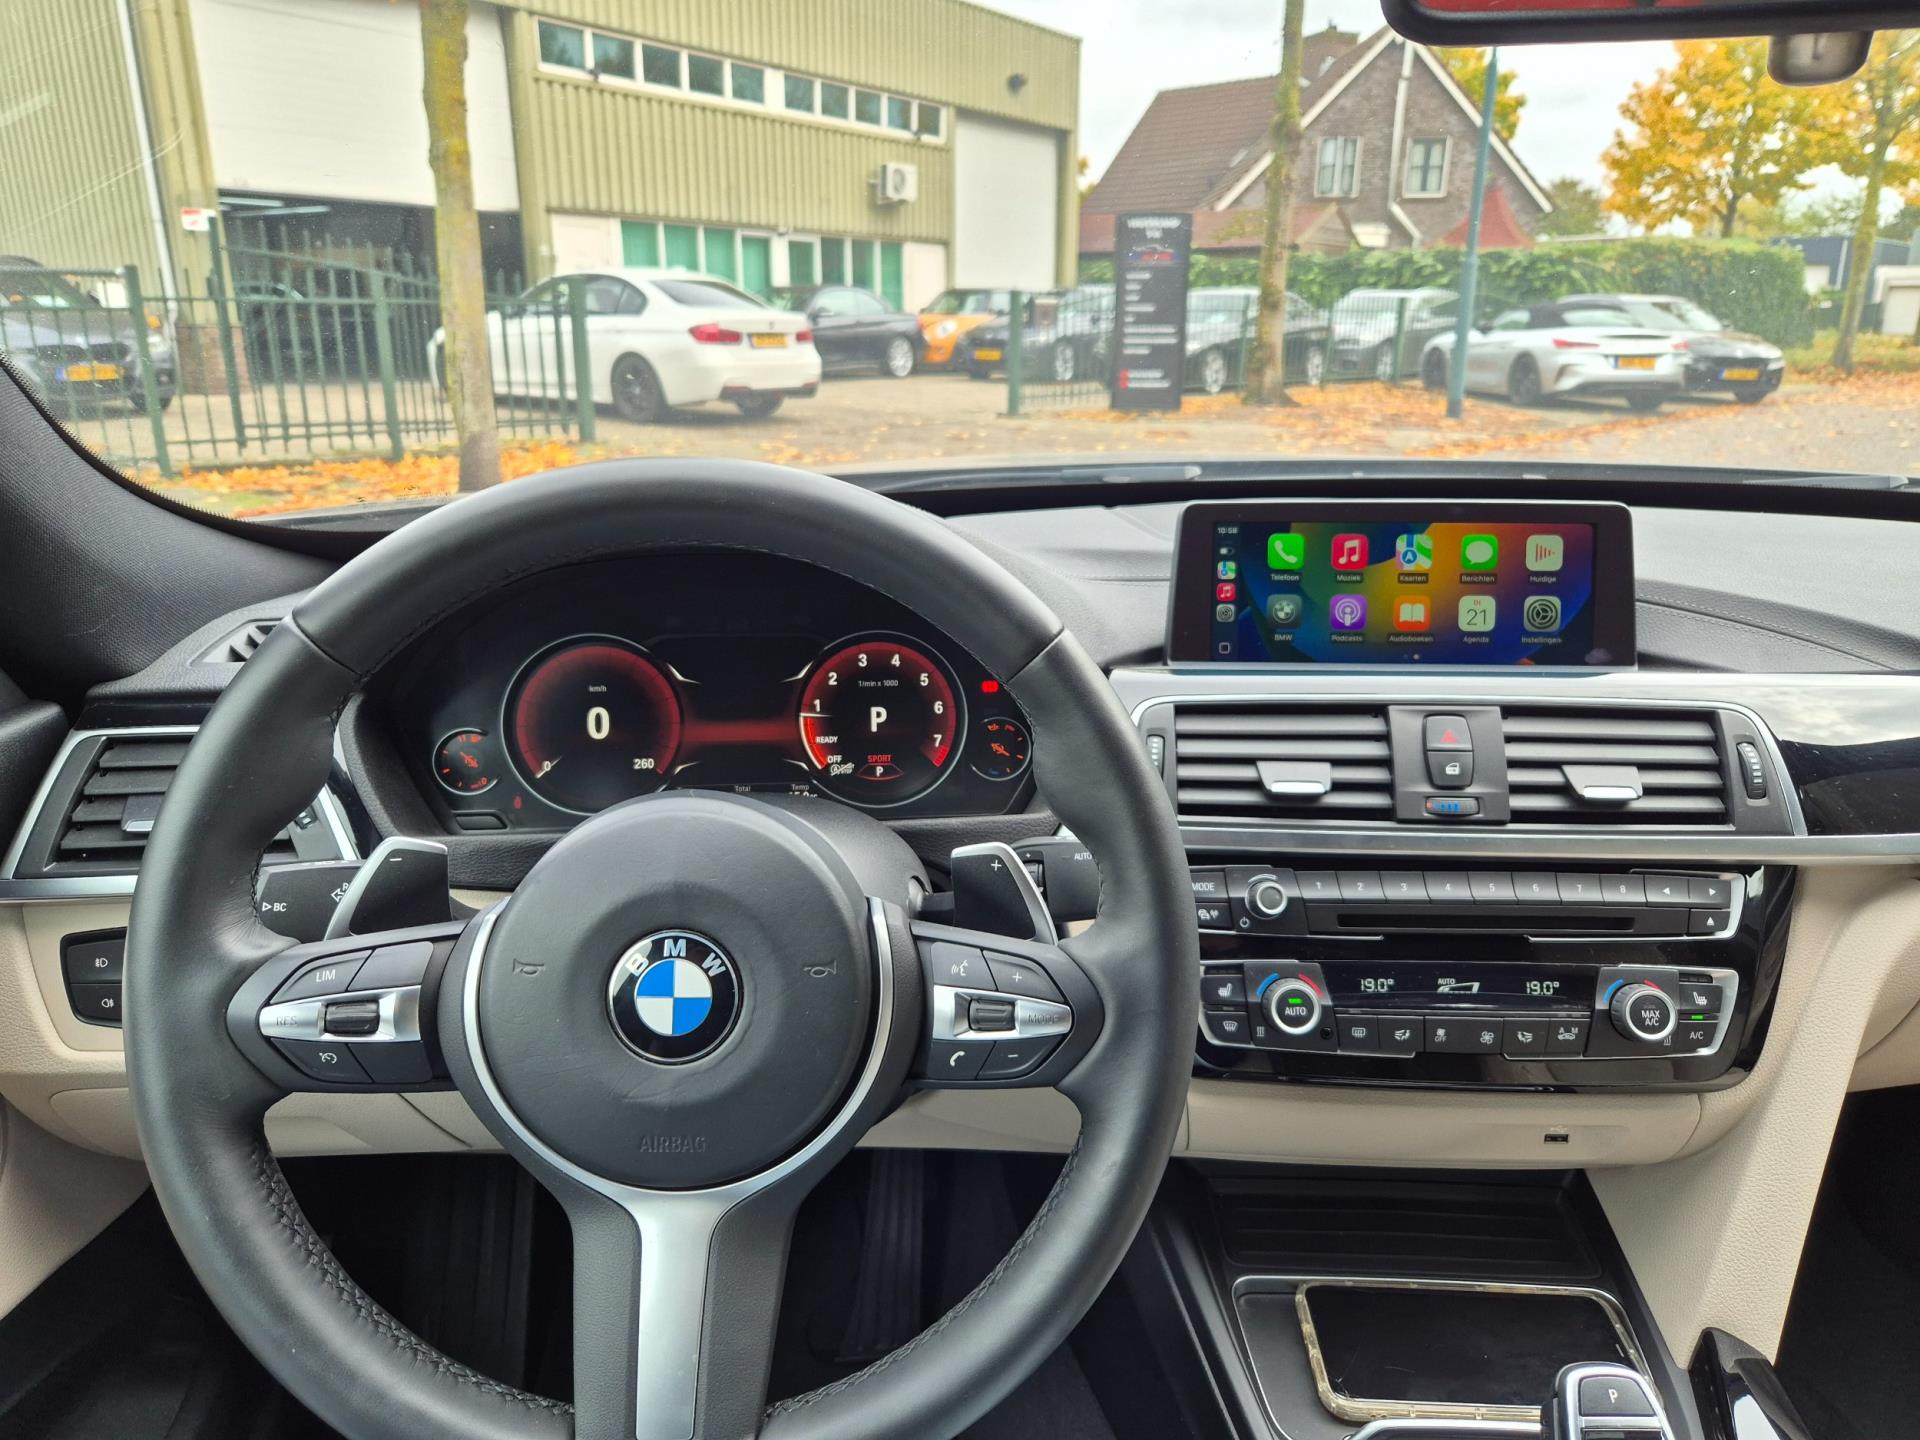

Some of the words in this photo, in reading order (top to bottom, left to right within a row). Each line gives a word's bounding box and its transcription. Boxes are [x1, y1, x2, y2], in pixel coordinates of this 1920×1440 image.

[1466, 609, 1487, 626] 21
[1463, 636, 1489, 644] Agenda
[858, 654, 868, 667] 3
[891, 654, 901, 667] 4
[828, 672, 838, 685] 2
[920, 673, 929, 686] 5
[814, 699, 821, 712] 1
[934, 701, 943, 713] 6
[586, 706, 610, 740] 0
[870, 706, 887, 732] P
[816, 736, 838, 744] READY
[933, 734, 943, 747] 7
[633, 758, 655, 769] 260
[827, 755, 843, 763] OFF
[867, 754, 892, 763] SPORT
[876, 766, 884, 777] P
[1191, 881, 1215, 891] MODE
[1357, 882, 1364, 890] 2
[1401, 883, 1407, 891] 3
[1444, 883, 1451, 891] 4
[1488, 884, 1495, 892] 5
[1532, 884, 1539, 892] 6
[1576, 884, 1583, 893] 7
[1619, 885, 1626, 893] 8
[273, 902, 287, 911] BC
[625, 938, 726, 977] BMW
[316, 969, 336, 982] LIM
[1285, 1007, 1306, 1016] AUTO
[1641, 1010, 1660, 1018] MAX
[276, 1015, 297, 1025] RES
[1645, 1017, 1660, 1026] A/C
[1434, 1034, 1447, 1042] OFF
[1689, 1031, 1704, 1040] A/C
[640, 1136, 707, 1153] AIRBAG
[1608, 1388, 1618, 1403] P
